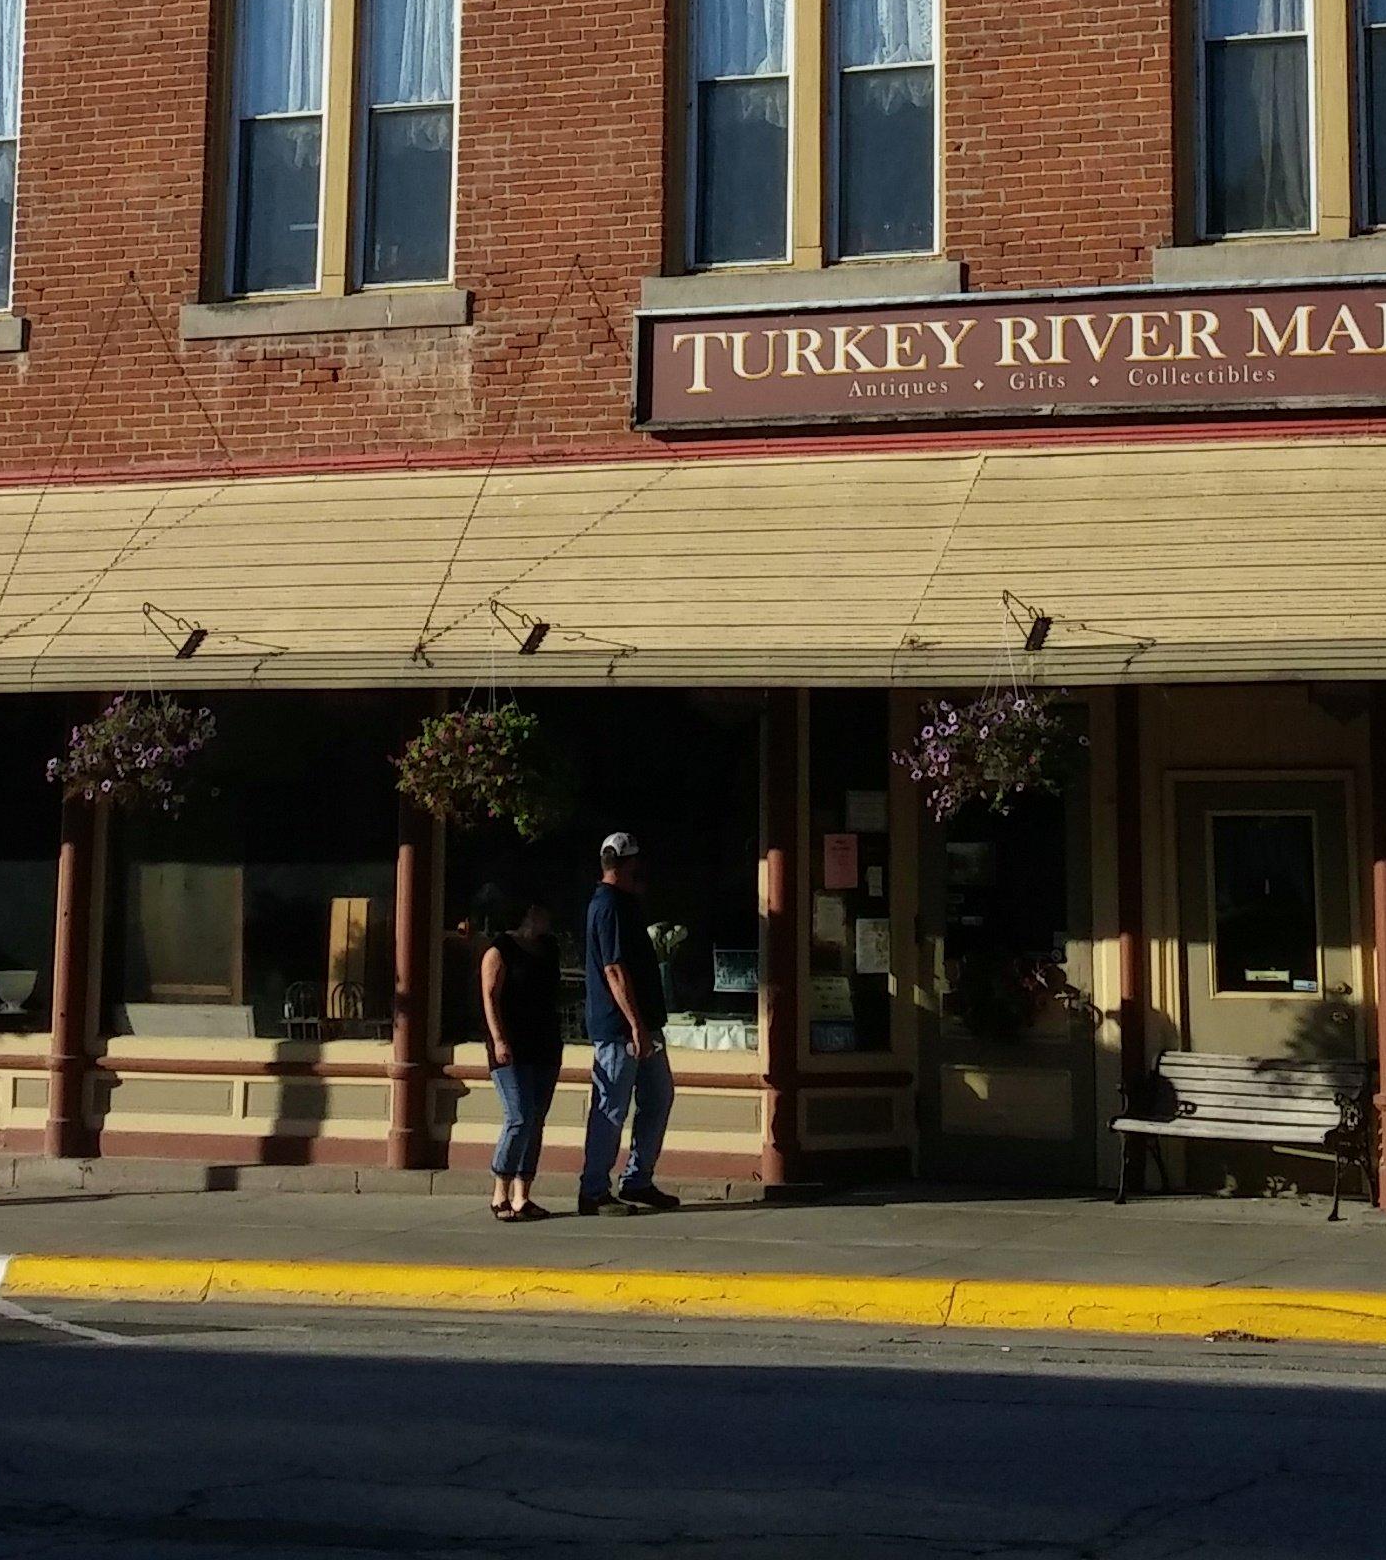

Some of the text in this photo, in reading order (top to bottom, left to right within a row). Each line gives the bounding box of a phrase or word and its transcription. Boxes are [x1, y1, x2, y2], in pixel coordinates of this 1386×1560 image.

[672, 319, 978, 395] TURKEY
[994, 309, 1228, 367] RIVER
[848, 364, 1277, 399] Antiques Gifts Collectibles
